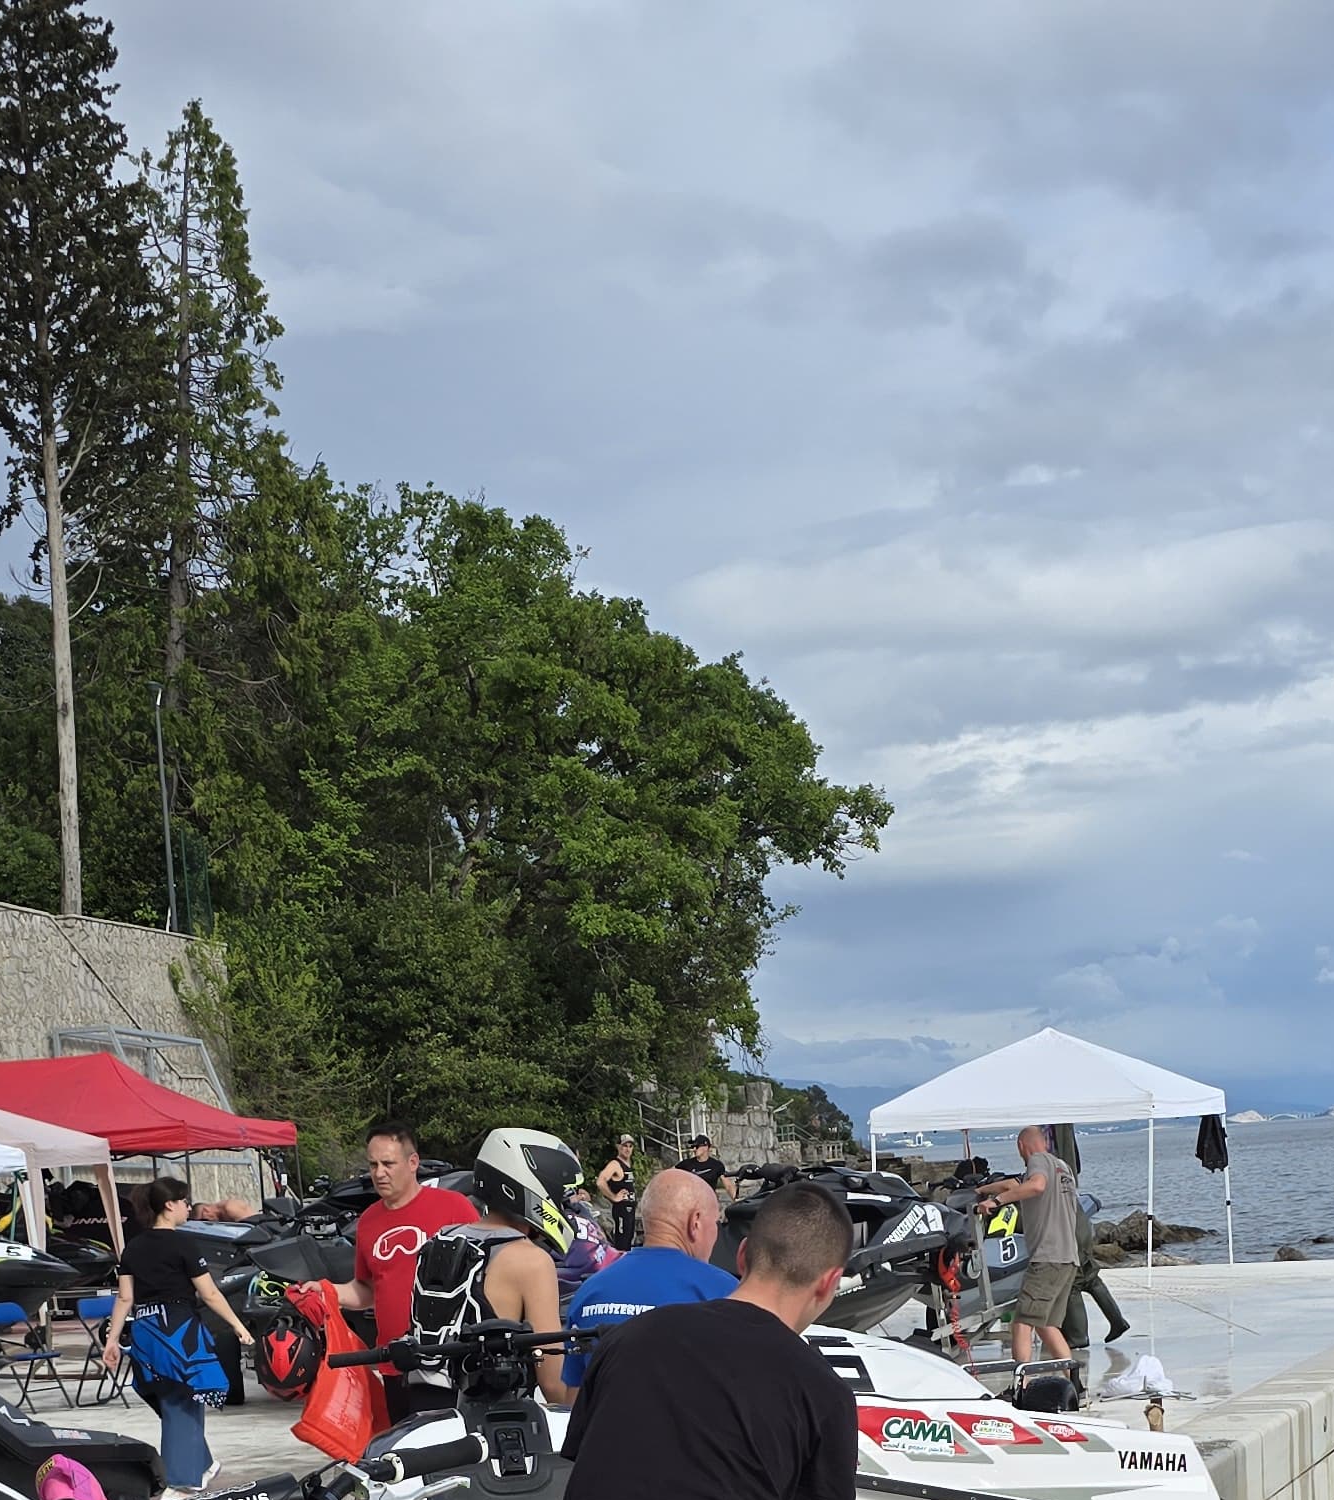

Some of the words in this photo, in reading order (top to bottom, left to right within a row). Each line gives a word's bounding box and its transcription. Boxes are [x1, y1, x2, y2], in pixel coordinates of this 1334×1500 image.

[532, 1203, 557, 1226] THOR
[1002, 1238, 1016, 1262] 5
[884, 1417, 953, 1444] CAMA
[1117, 1450, 1188, 1473] YAMAHA
